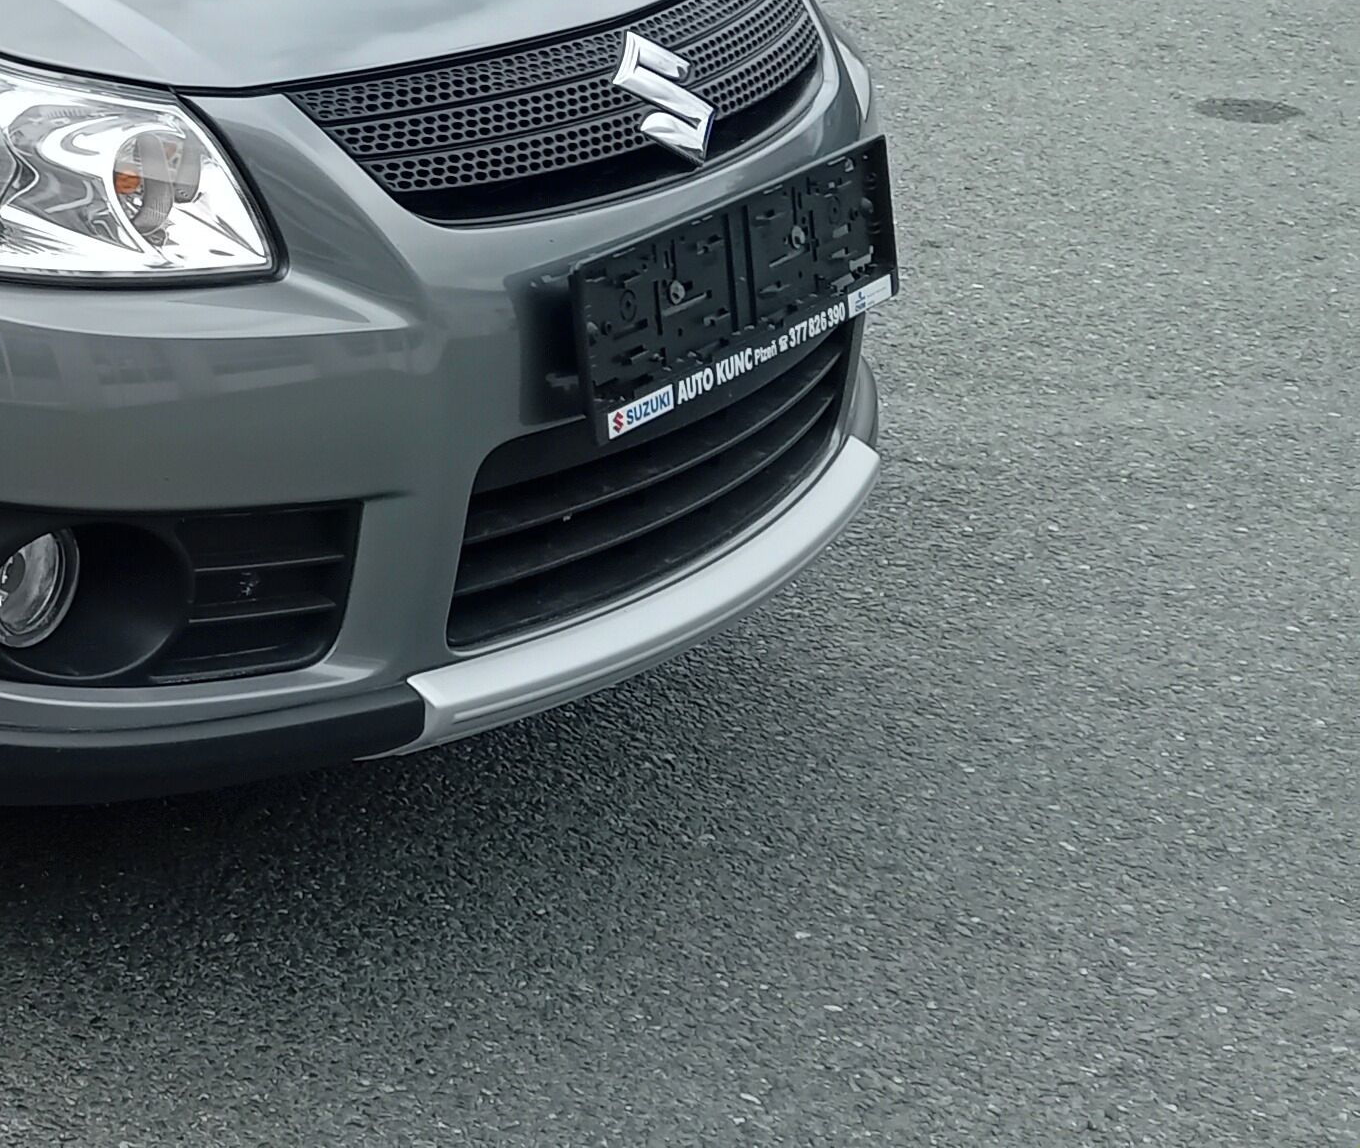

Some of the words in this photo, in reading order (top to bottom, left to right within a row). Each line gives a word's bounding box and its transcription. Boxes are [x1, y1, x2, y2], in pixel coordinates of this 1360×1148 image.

[626, 391, 671, 425] SUZUKI
[677, 367, 714, 405] AUTO
[715, 347, 753, 385] KUNC
[754, 339, 778, 366] Plzeň
[788, 320, 808, 348] 377
[808, 311, 827, 338] 826
[827, 301, 846, 328] 390
